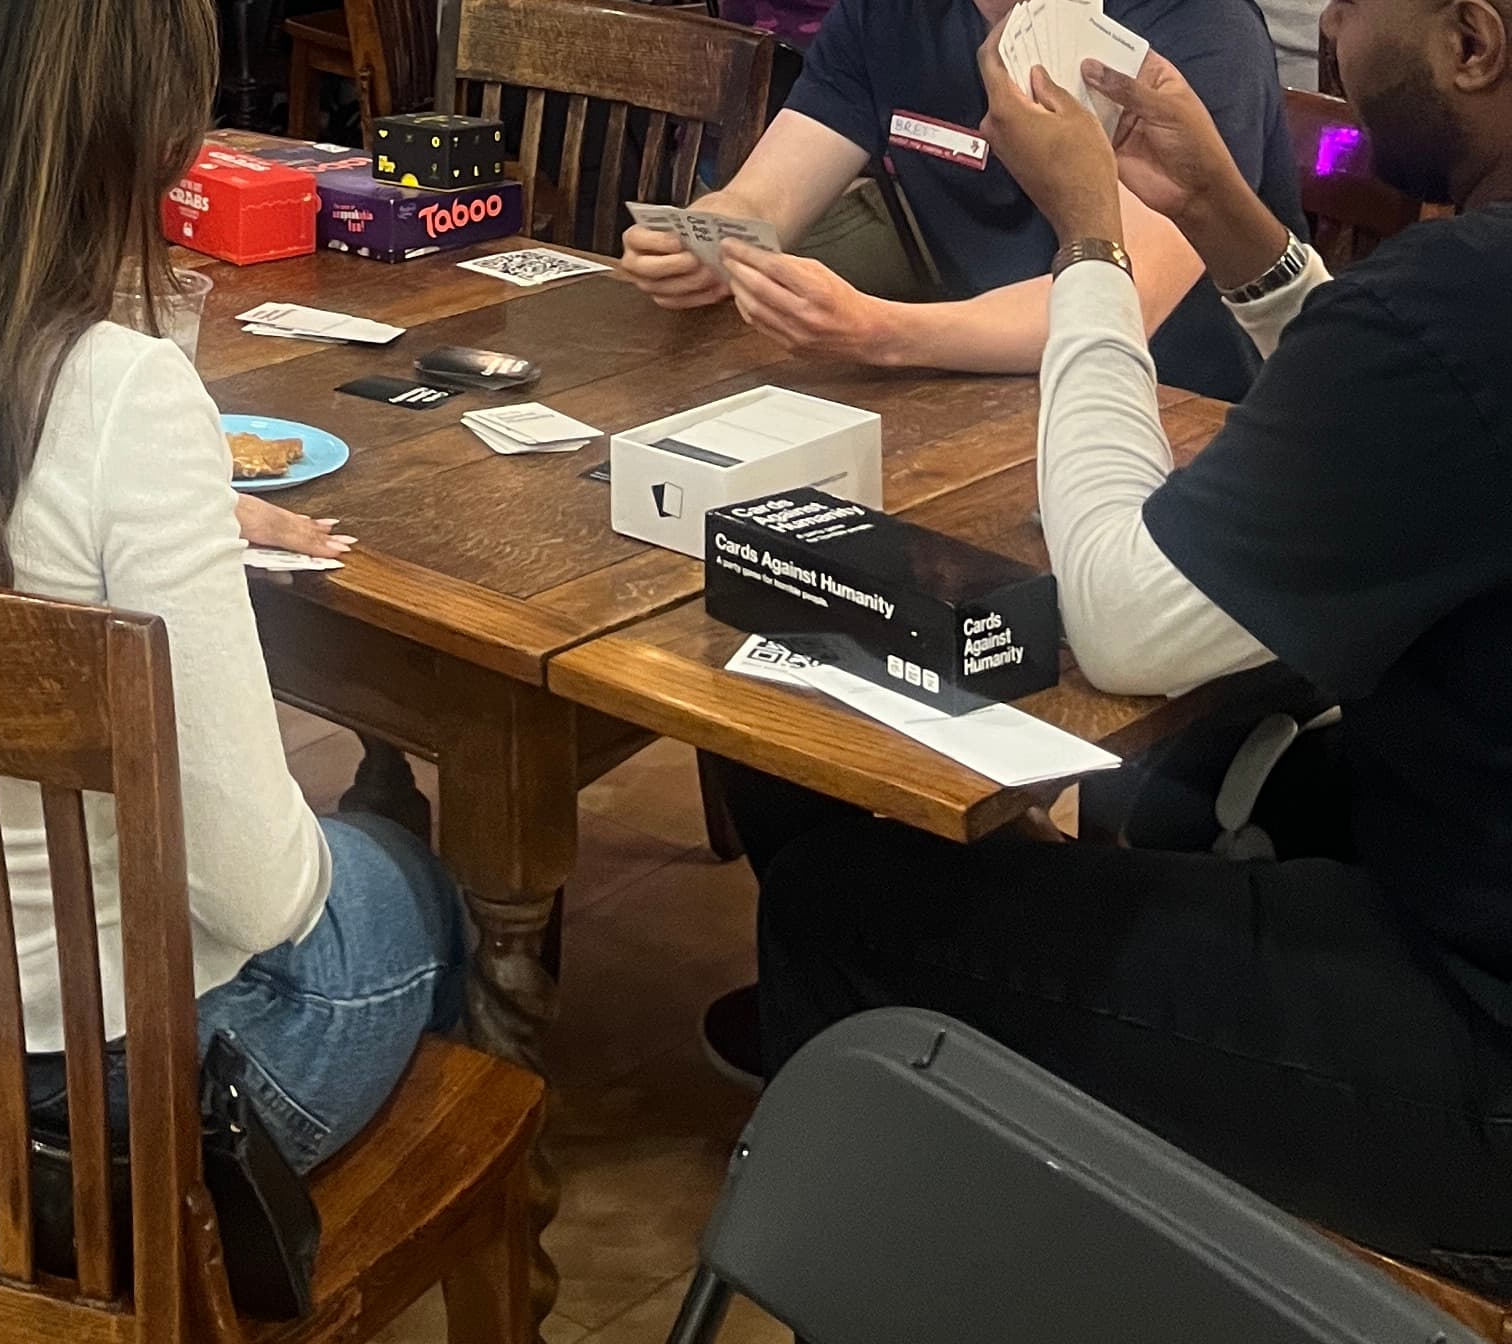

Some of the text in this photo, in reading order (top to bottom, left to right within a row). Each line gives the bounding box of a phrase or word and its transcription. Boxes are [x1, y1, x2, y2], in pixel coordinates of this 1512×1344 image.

[169, 187, 210, 212] CRABS
[418, 194, 503, 239] Taboo
[731, 499, 795, 518] Cards
[768, 505, 866, 533] Humanity
[715, 532, 758, 563] Cards
[761, 551, 817, 587] Against
[820, 572, 895, 620] Humanity
[963, 612, 1002, 637] Cards
[963, 628, 1012, 657] Against
[963, 646, 1024, 676] Humanity
